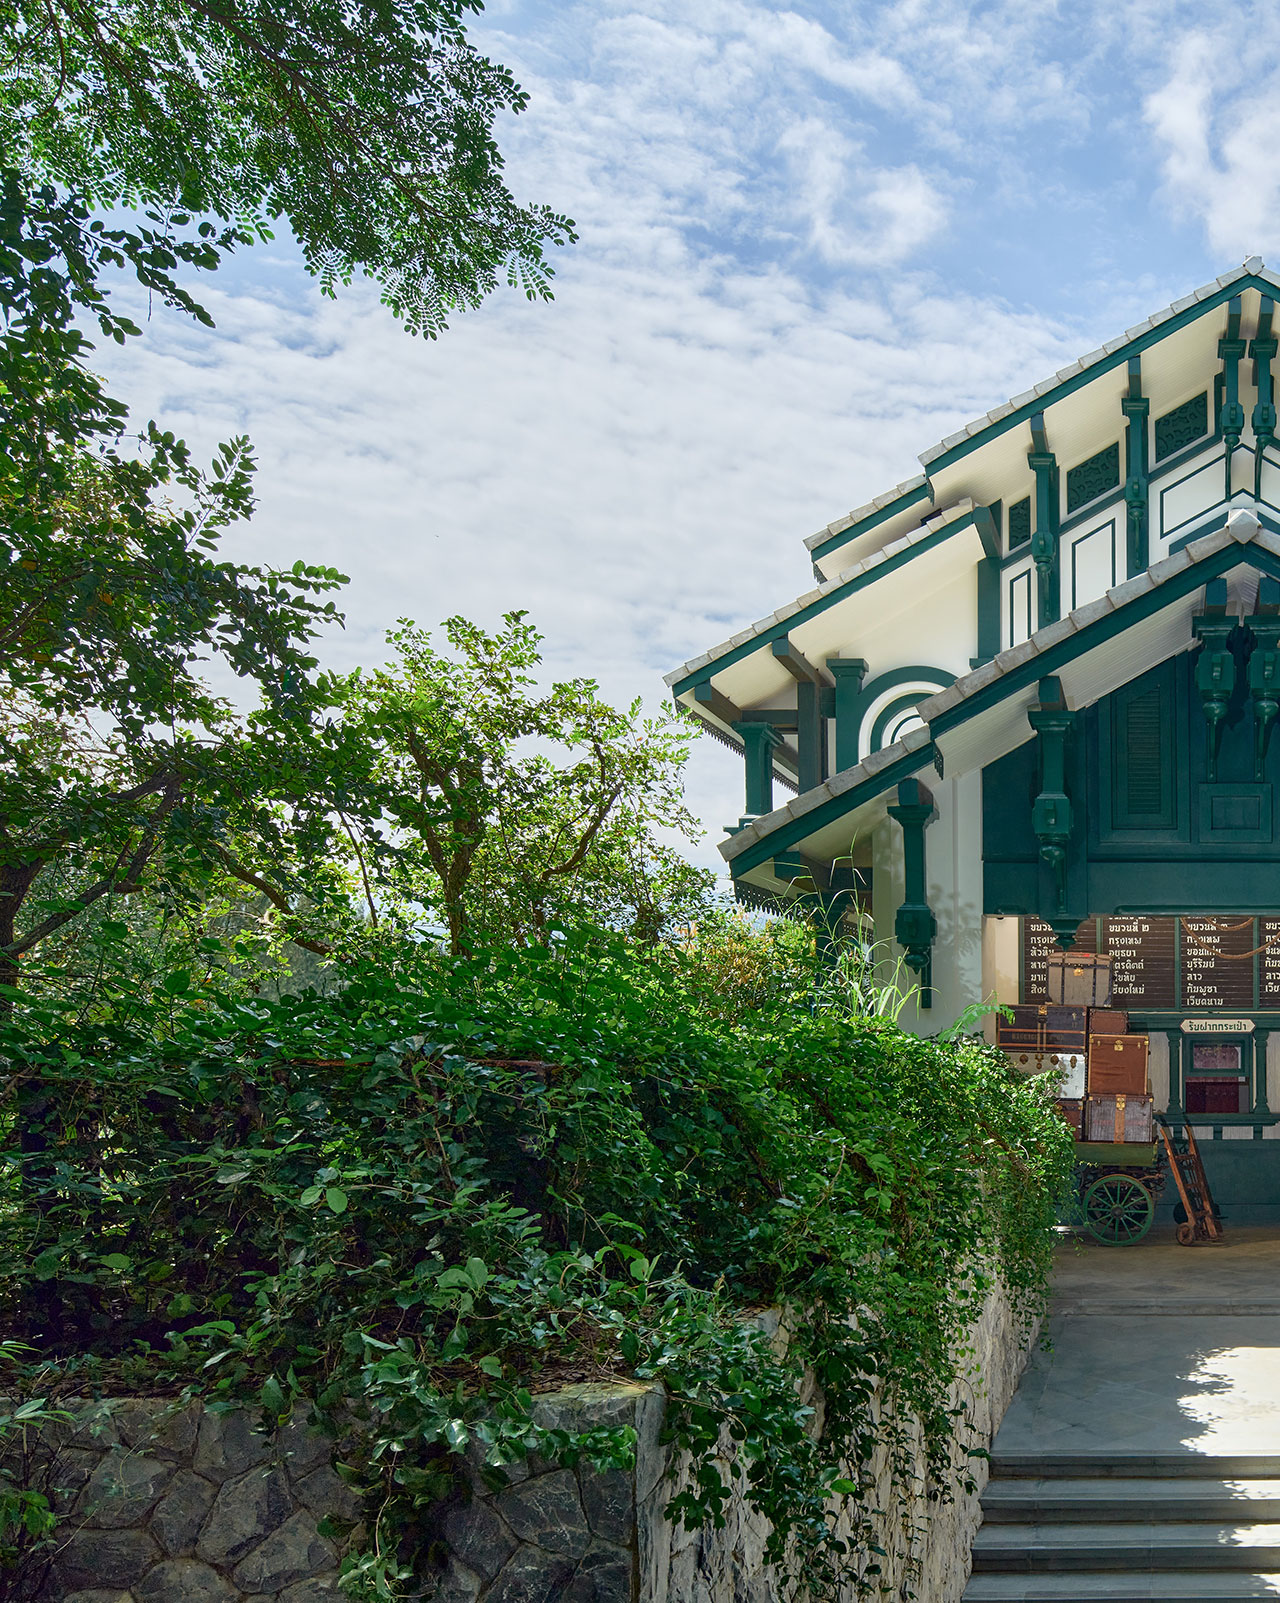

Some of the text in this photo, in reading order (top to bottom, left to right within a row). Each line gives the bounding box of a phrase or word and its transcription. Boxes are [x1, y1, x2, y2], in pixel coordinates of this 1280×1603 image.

[1109, 919, 1139, 932] ขบวนที่
[1108, 937, 1142, 947] กรุงเทพ
[1108, 949, 1137, 960] อยุธยา
[1186, 973, 1203, 981] ลาว
[1112, 983, 1145, 994] ชียงใหม่
[1186, 983, 1218, 996] กัมพูชา
[1188, 1020, 1247, 1031] รับฝากกระเป๋า
